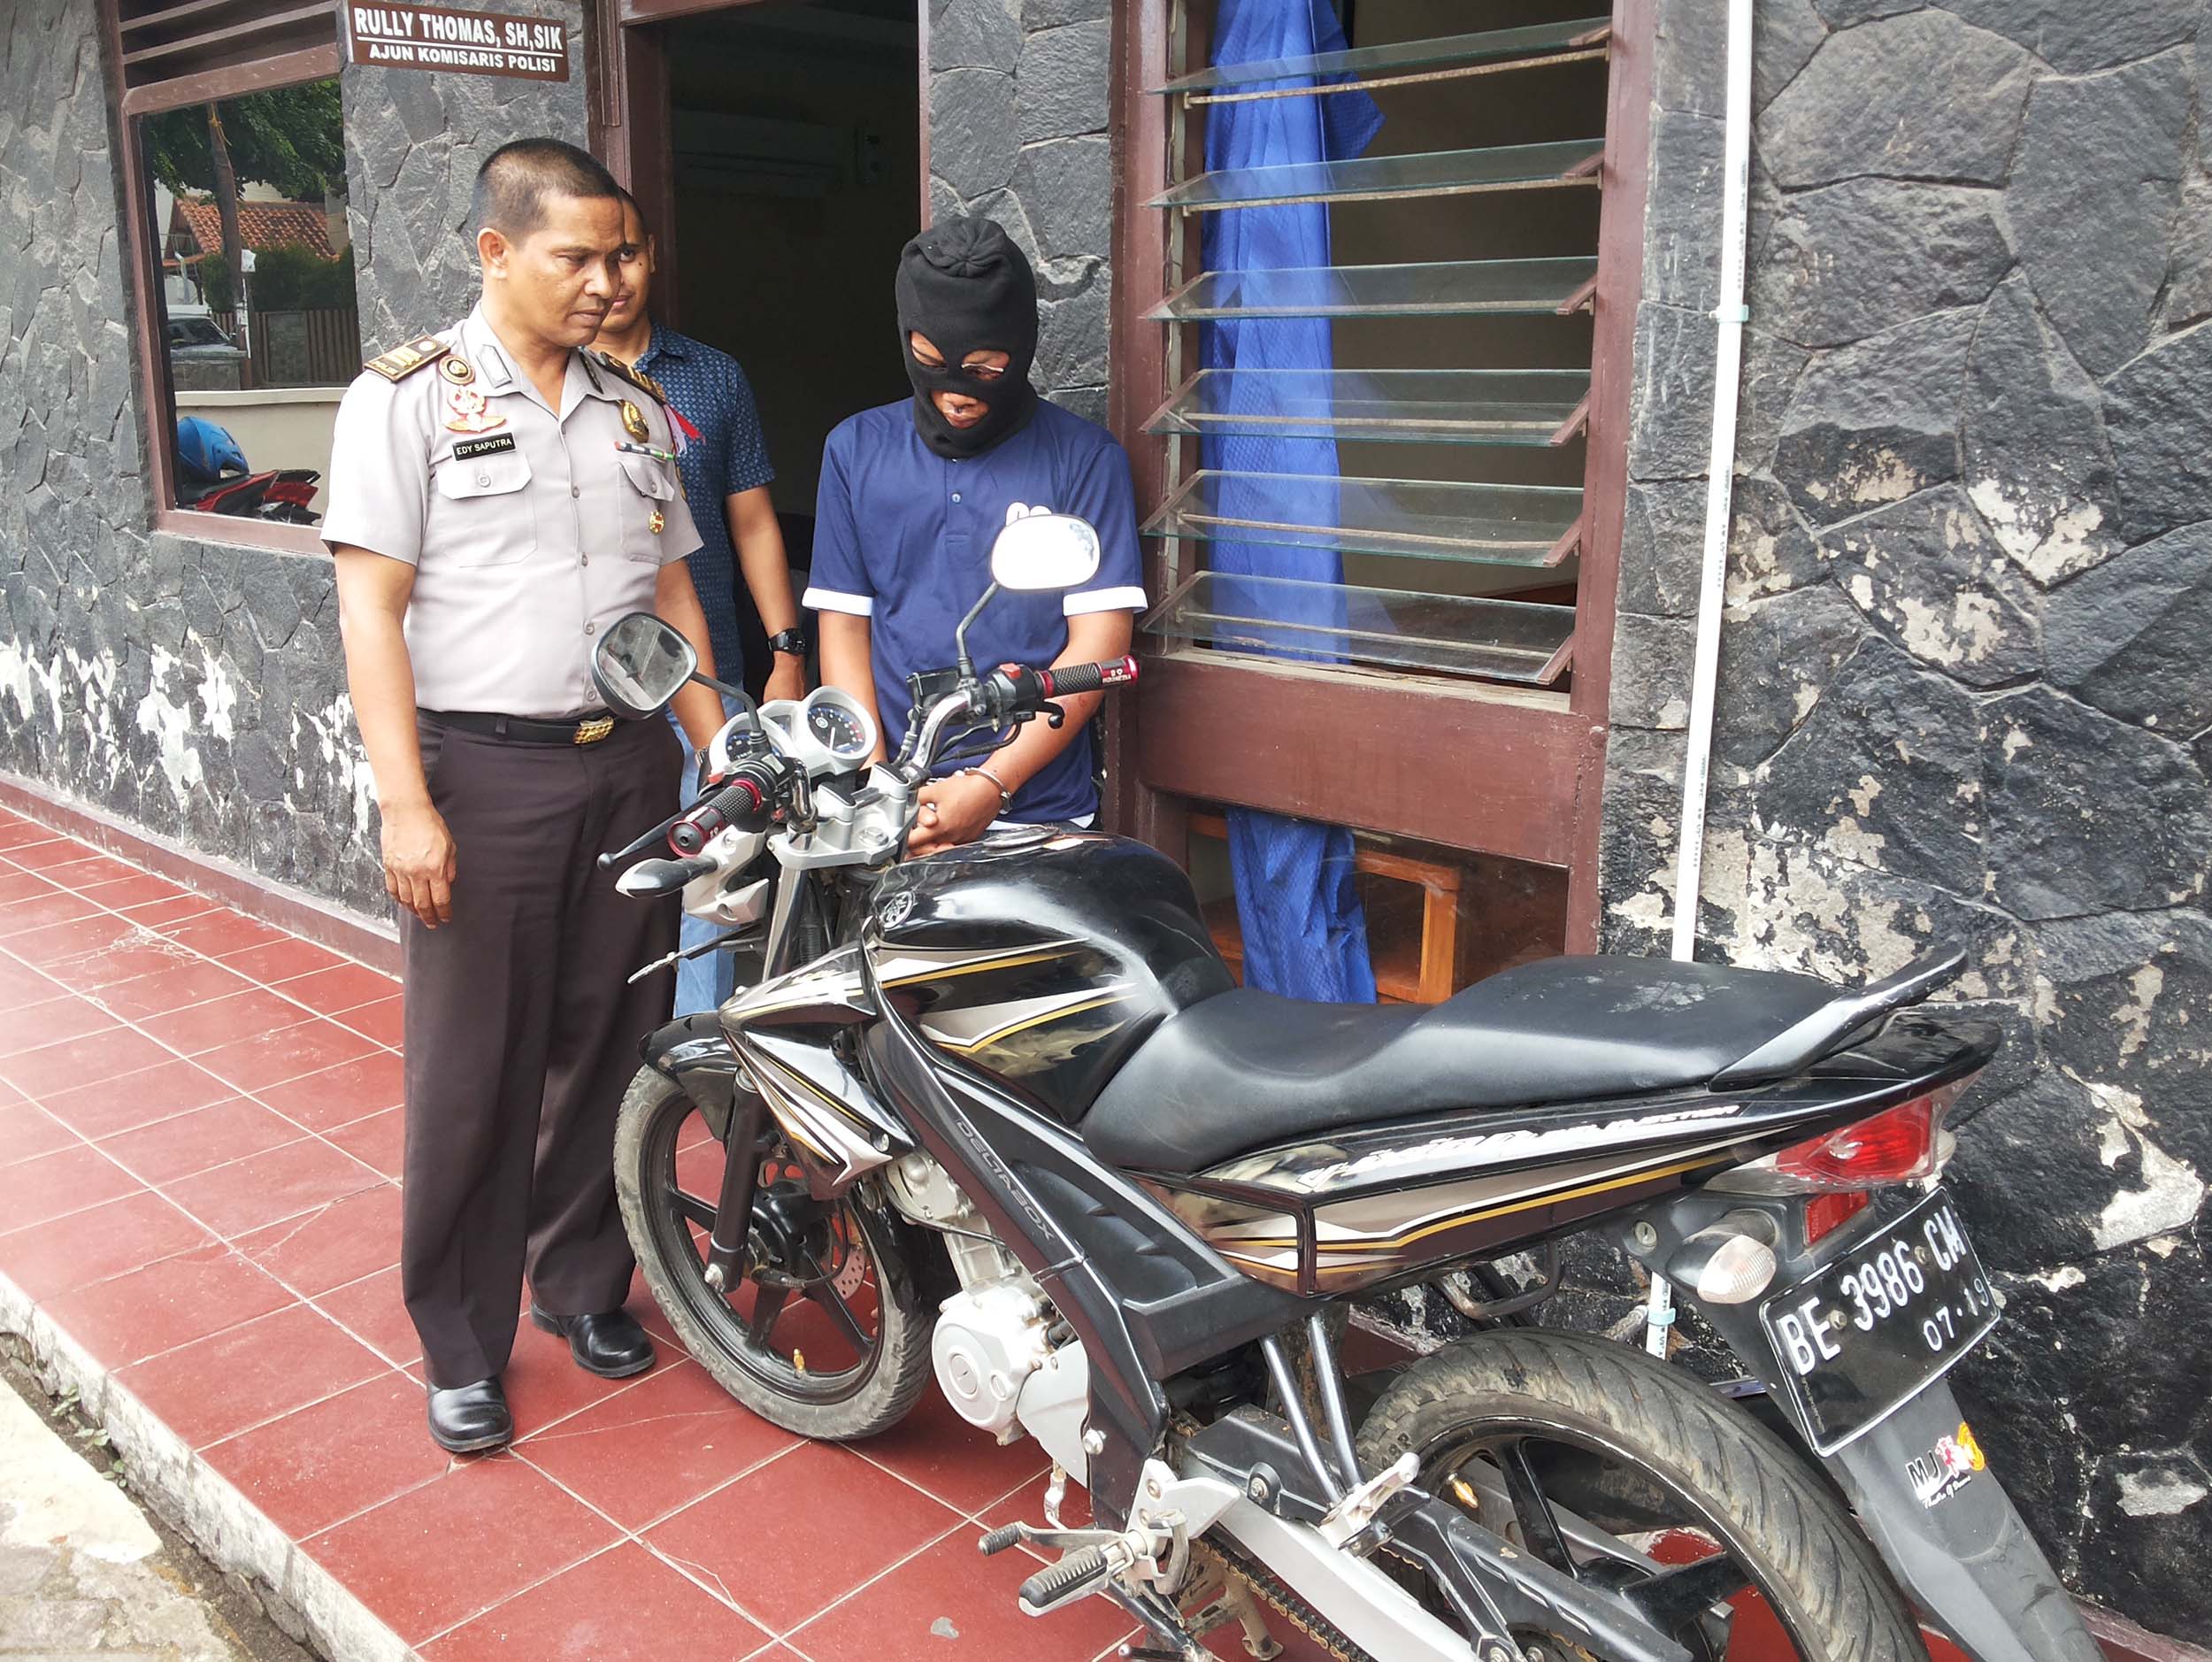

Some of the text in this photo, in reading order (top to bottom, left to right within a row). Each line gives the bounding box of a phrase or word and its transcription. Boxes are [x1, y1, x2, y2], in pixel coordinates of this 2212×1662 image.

[354, 7, 563, 52] RULLY THOMAS, SH,SIK
[369, 44, 557, 72] AJUN KOMISARIS POLISI
[456, 438, 511, 455] EDY SAPUTRA
[956, 1120, 1055, 1241] DELTABOX
[1776, 1204, 1967, 1376] BE 3986 CM
